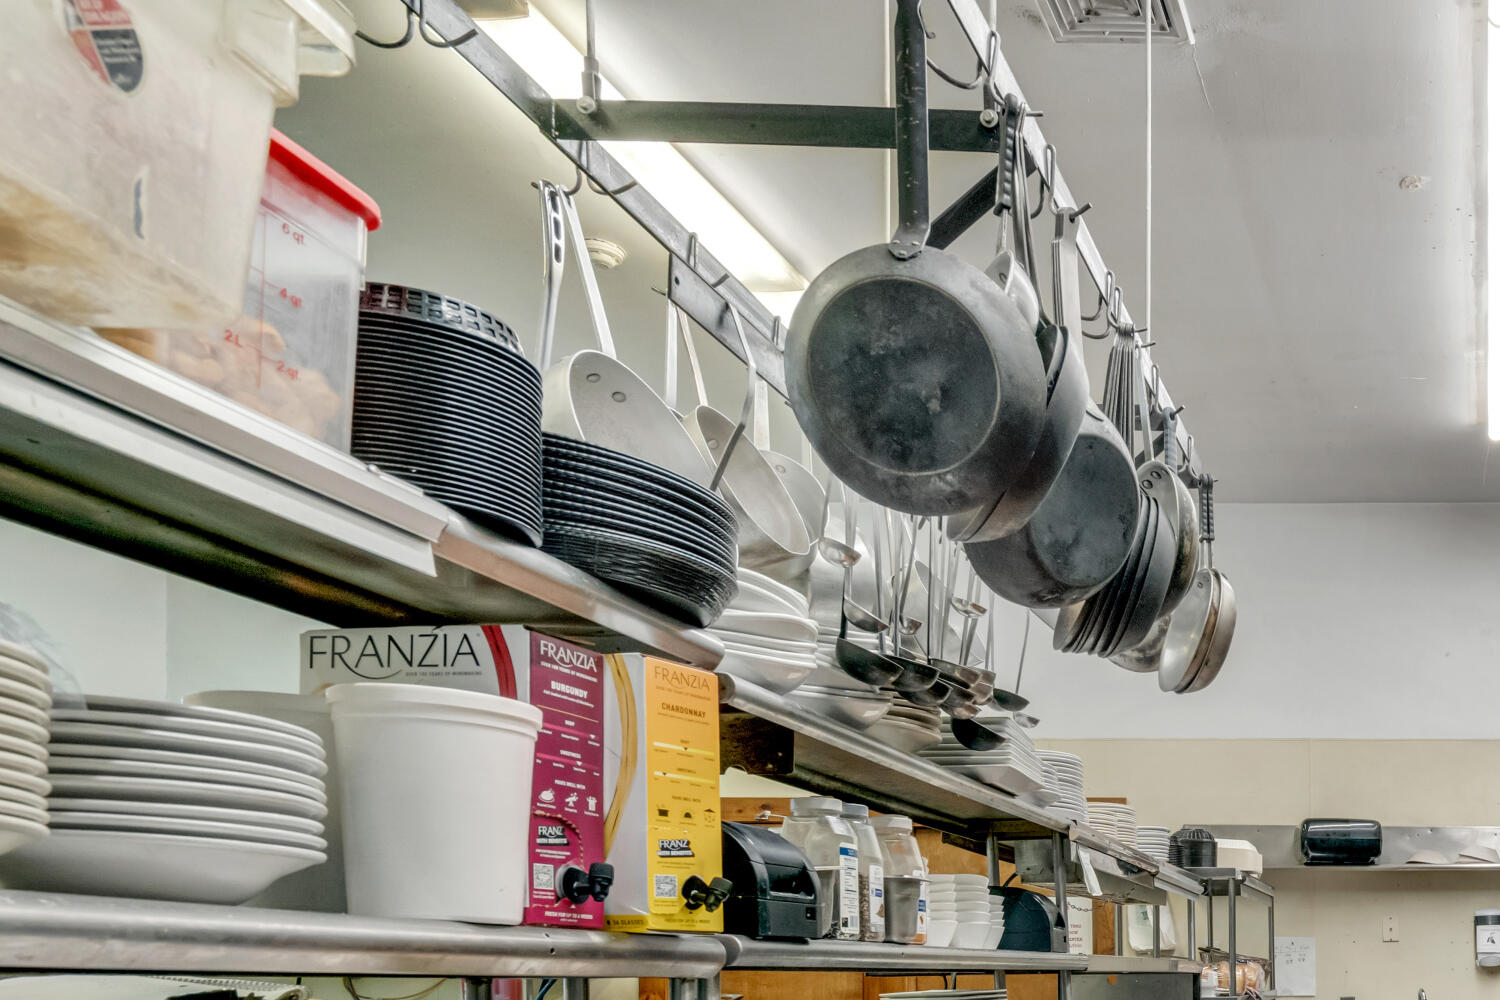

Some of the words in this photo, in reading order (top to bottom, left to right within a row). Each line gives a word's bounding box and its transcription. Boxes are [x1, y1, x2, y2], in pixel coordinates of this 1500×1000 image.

[281, 223, 290, 234] 6
[293, 231, 304, 245] qt
[280, 288, 287, 299] 4
[276, 360, 285, 372] 2
[309, 634, 480, 679] FRANZIA
[541, 640, 597, 673] FRANZIA
[654, 666, 711, 692] FRANZIA
[551, 680, 588, 699] BURGUNDY
[661, 702, 706, 718] CHARDONNAY
[538, 825, 564, 838] FRANZ
[658, 839, 689, 850] FRANZ
